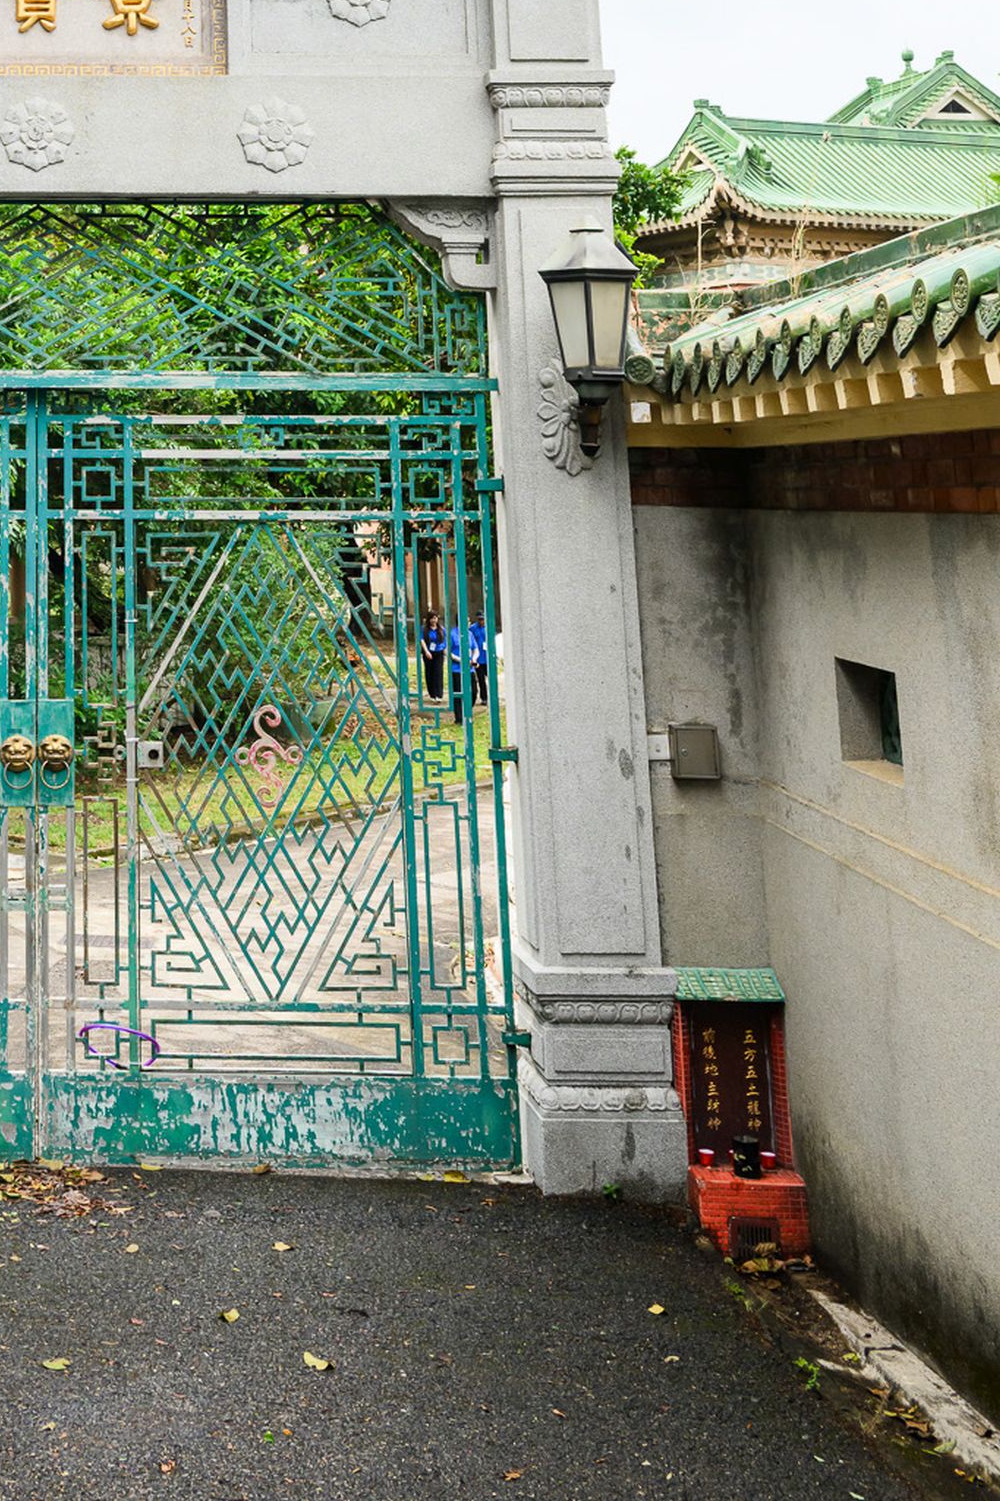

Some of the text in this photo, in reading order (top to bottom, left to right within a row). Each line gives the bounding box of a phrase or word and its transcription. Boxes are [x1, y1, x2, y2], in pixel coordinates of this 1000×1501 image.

[701, 1027, 722, 1132] 前後地主財神
[743, 1029, 762, 1132] 五方五土龍神
